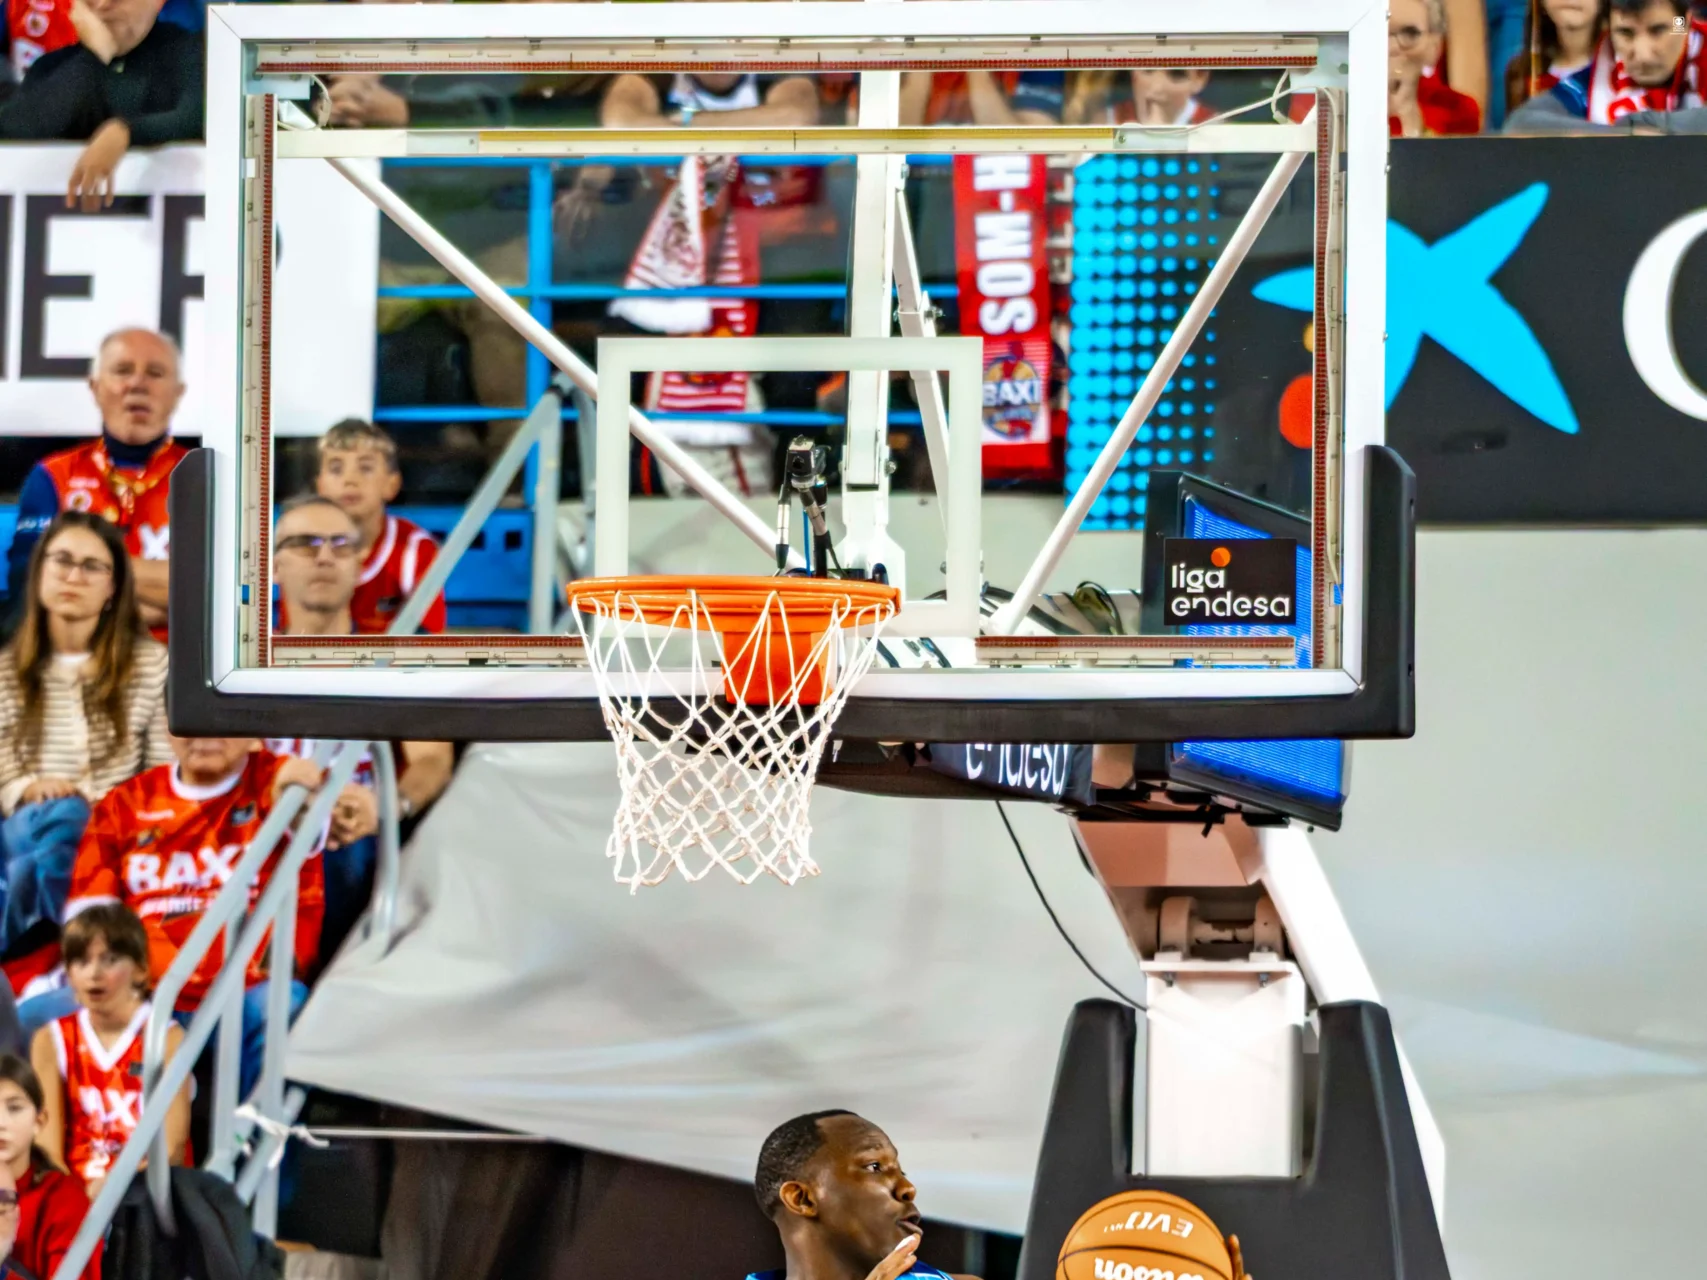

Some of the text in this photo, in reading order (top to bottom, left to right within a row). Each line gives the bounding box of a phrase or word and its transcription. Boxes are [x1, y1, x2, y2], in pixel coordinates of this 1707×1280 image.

[1172, 563, 1225, 593] liga
[1171, 591, 1290, 617] endesa
[1125, 1211, 1193, 1238] EVO
